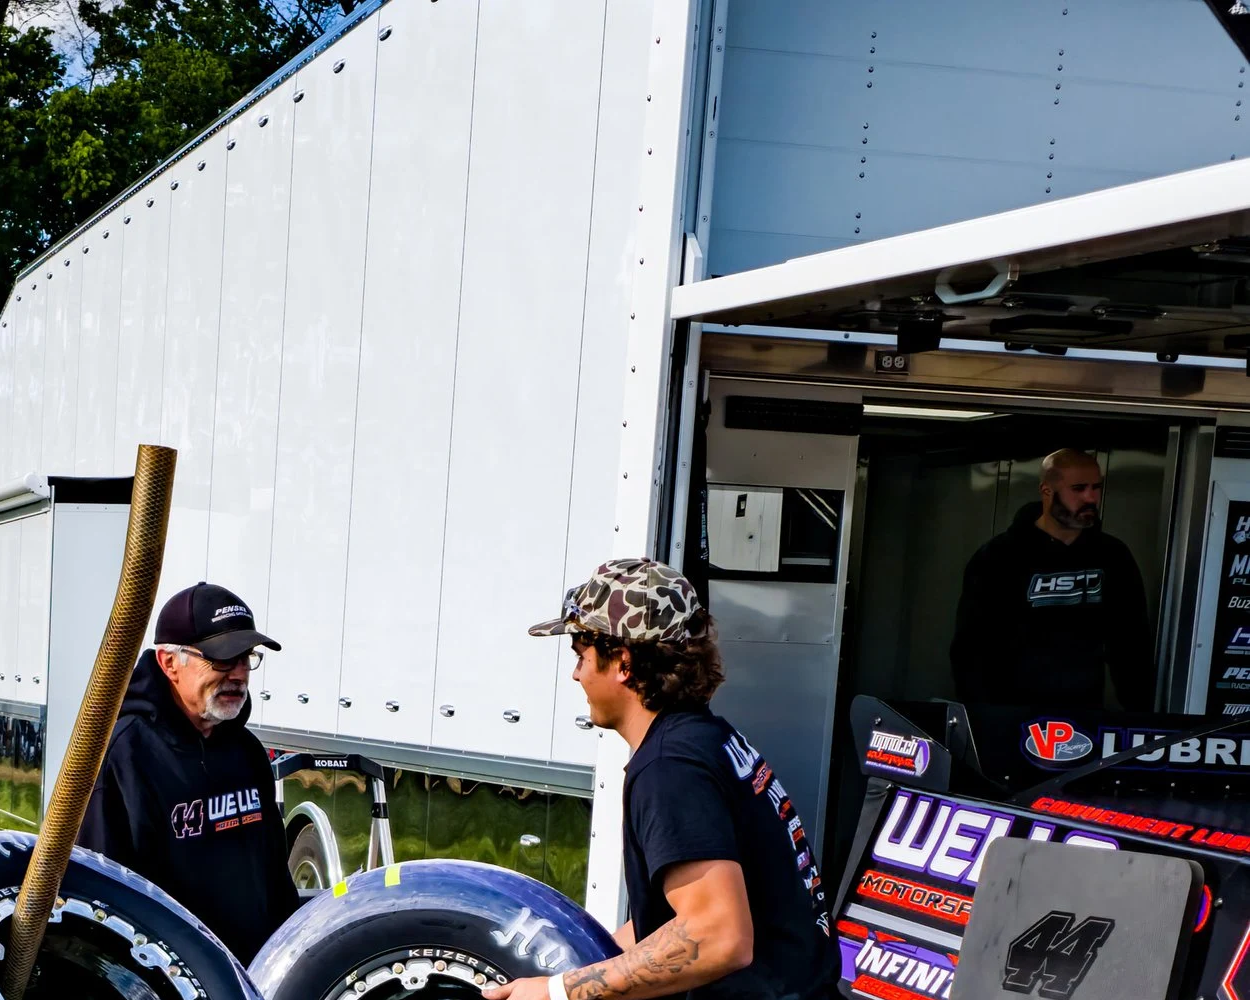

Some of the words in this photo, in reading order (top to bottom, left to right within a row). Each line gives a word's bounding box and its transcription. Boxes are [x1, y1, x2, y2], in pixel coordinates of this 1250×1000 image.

[1029, 721, 1074, 761] VP
[314, 759, 348, 768] KOBALT
[171, 799, 203, 839] 44
[208, 788, 261, 820] WELLS
[408, 949, 480, 967] KEIZER
